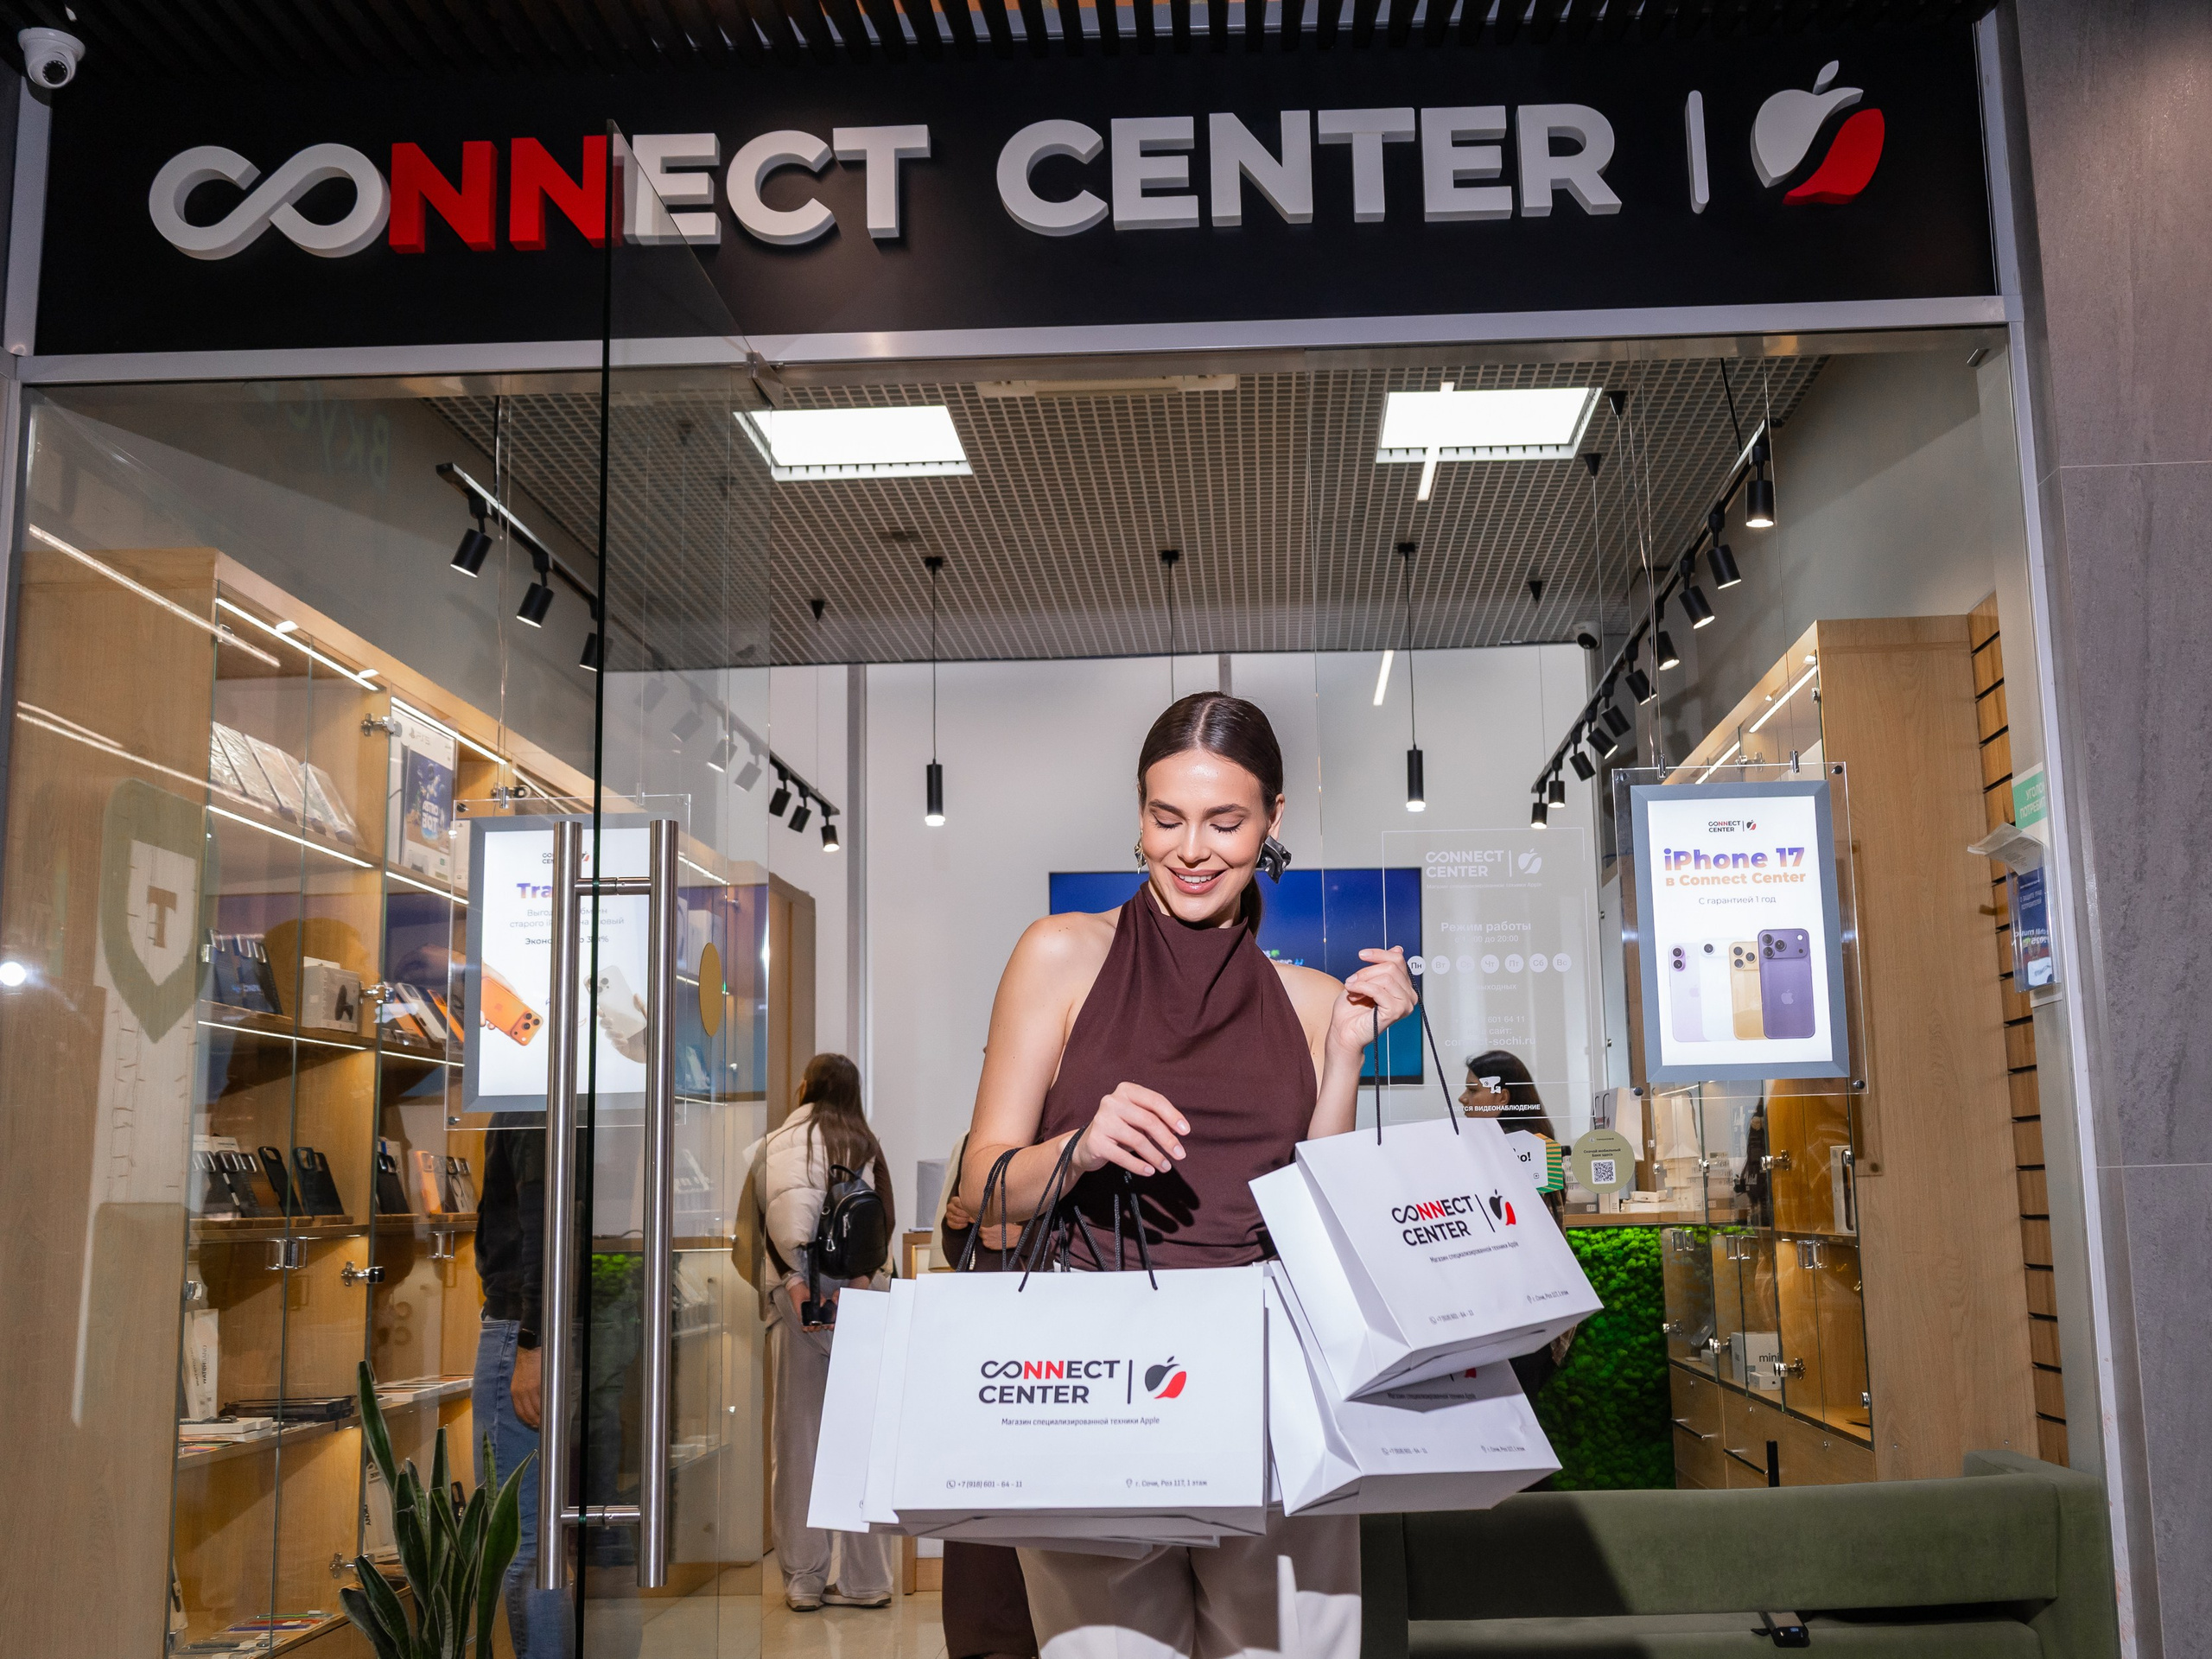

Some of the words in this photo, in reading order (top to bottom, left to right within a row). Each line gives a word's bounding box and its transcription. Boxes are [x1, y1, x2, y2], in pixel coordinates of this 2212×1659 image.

[149, 124, 931, 260] CONNECT
[996, 102, 1623, 238] CENTER
[1426, 850, 1503, 863] CONNECT
[1663, 848, 1768, 871] iPhone
[1776, 847, 1805, 868] 17
[1426, 865, 1488, 878] CENTER
[1679, 874, 1747, 887] Connect
[1751, 872, 1806, 884] Center
[1707, 896, 1753, 906] гарантией
[1761, 895, 1777, 904] год
[510, 920, 544, 929] старого
[1440, 922, 1483, 932] Режим
[1486, 920, 1531, 933] работы
[1391, 1195, 1474, 1224] CONNECT
[1402, 1220, 1472, 1246] CENTER
[1759, 1353, 1780, 1363] mini
[981, 1360, 1121, 1380] CONNECT
[978, 1385, 1090, 1404] CENTER
[1033, 1418, 1109, 1427] специализированной
[1140, 1416, 1160, 1427] Apple
